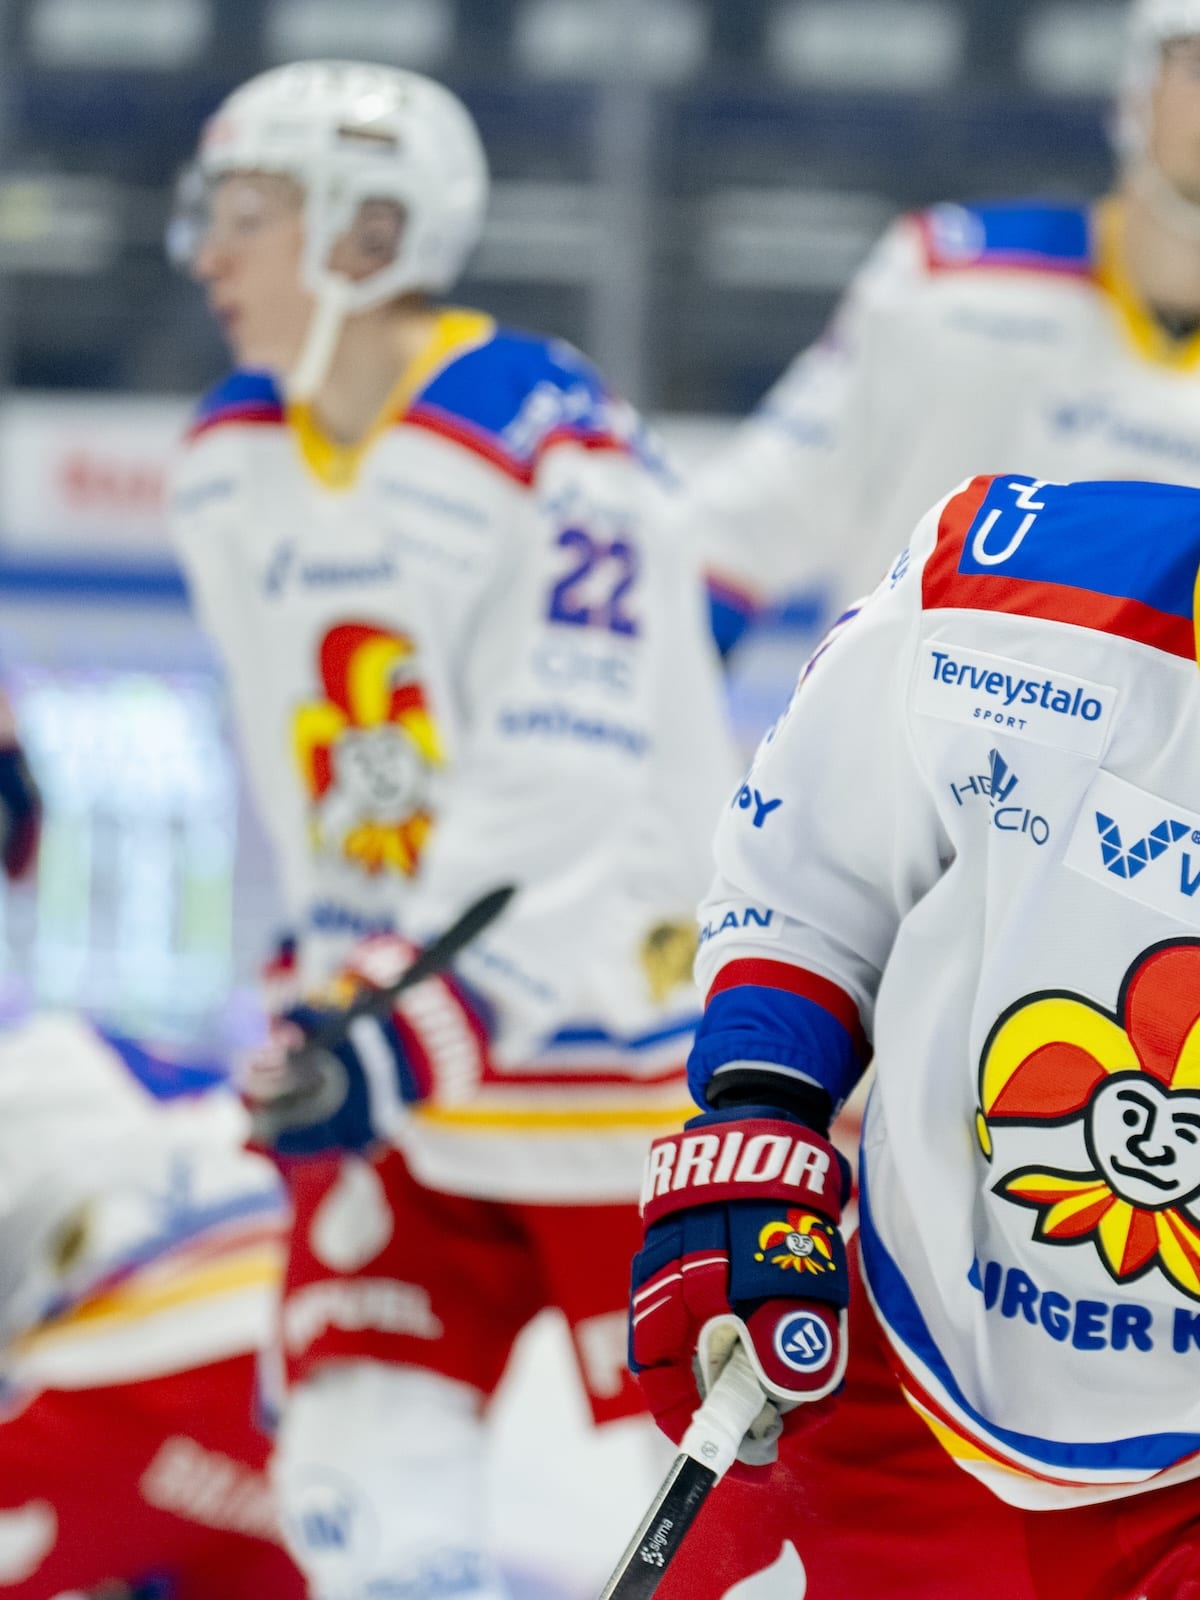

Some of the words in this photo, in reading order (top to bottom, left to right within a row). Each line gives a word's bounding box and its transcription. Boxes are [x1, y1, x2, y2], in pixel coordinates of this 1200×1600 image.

[548, 528, 639, 638] 22
[932, 652, 1103, 722] Terveystalo
[973, 708, 1027, 730] SPORT
[731, 783, 783, 828] OY
[639, 1131, 830, 1219] RRIOR
[650, 1517, 674, 1551] sigma
